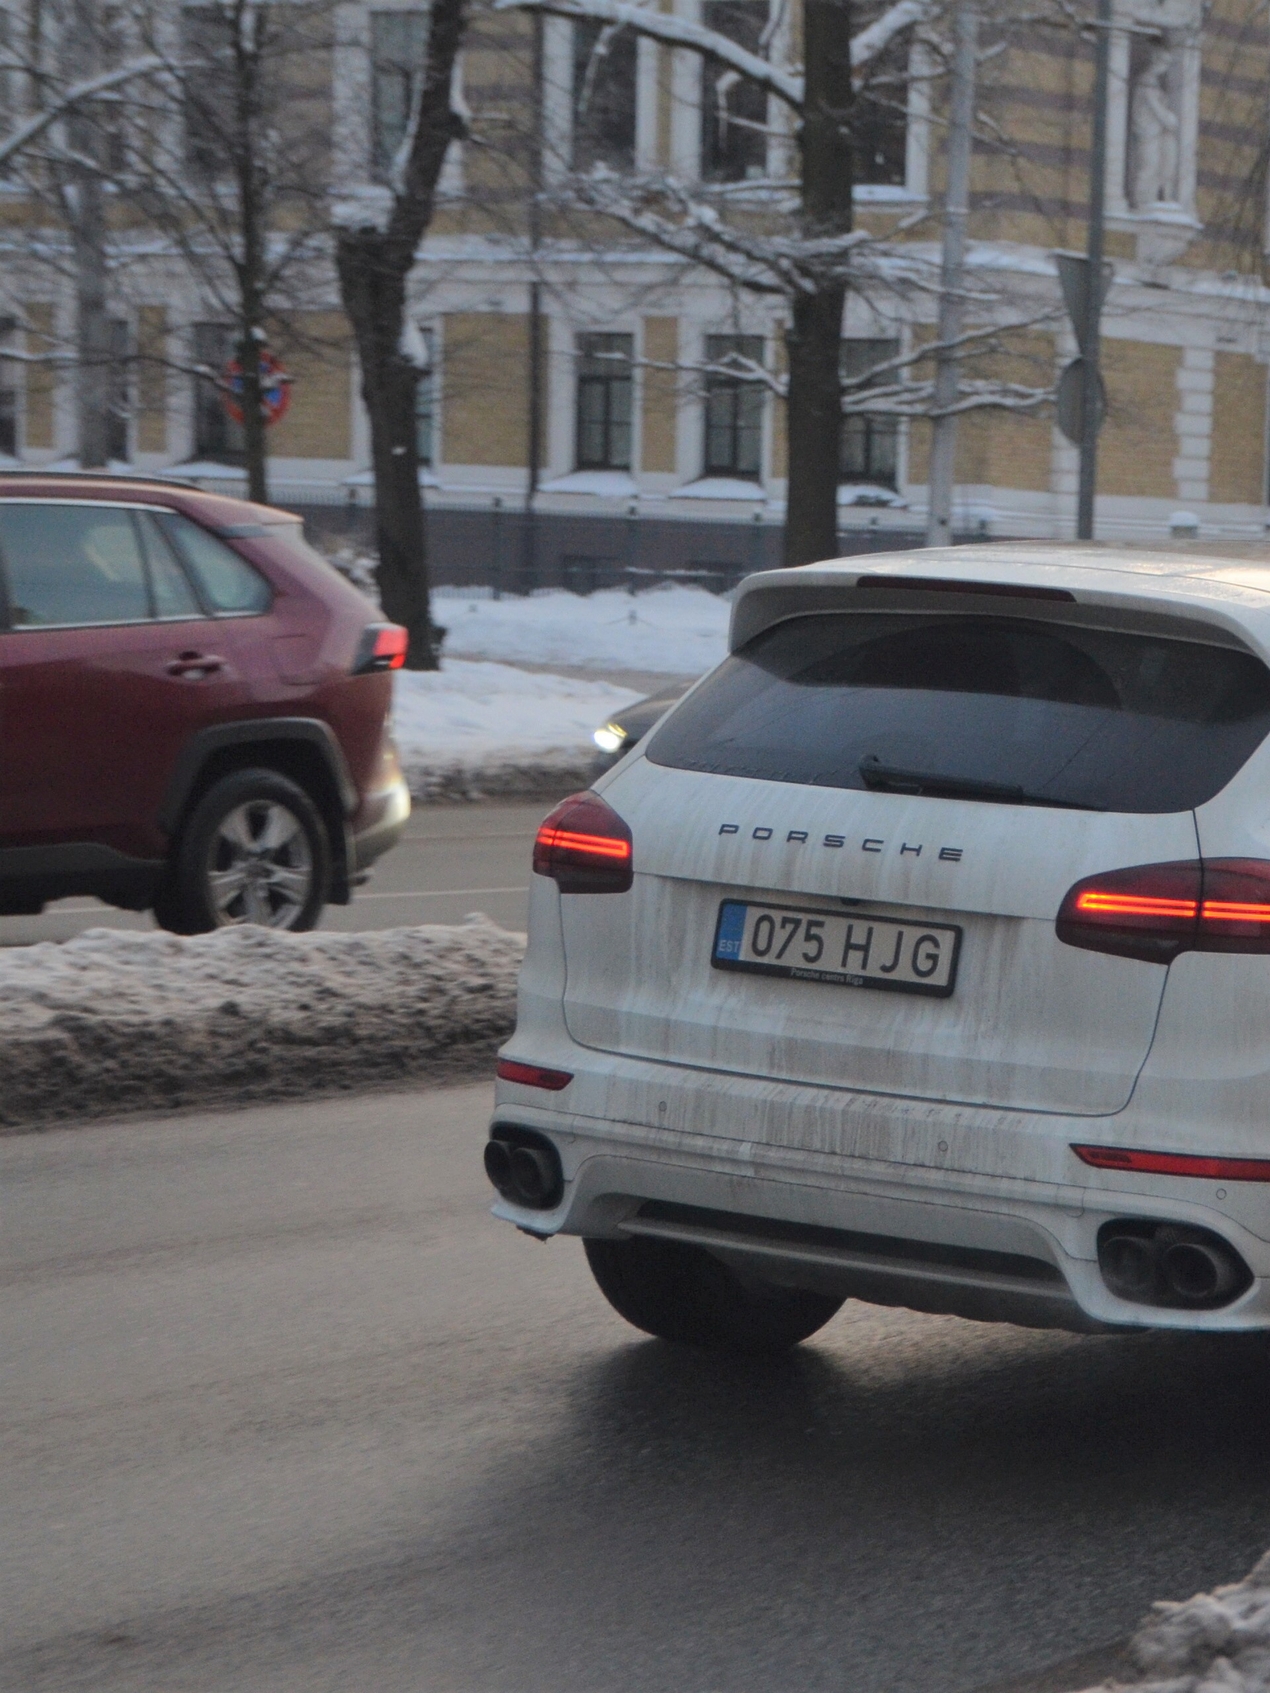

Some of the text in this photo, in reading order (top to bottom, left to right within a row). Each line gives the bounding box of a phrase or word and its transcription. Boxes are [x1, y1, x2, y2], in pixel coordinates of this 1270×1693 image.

[718, 823, 963, 862] PORSCHE
[719, 939, 740, 953] EST
[751, 914, 940, 978] 075 HJG
[790, 967, 820, 980] Porsche
